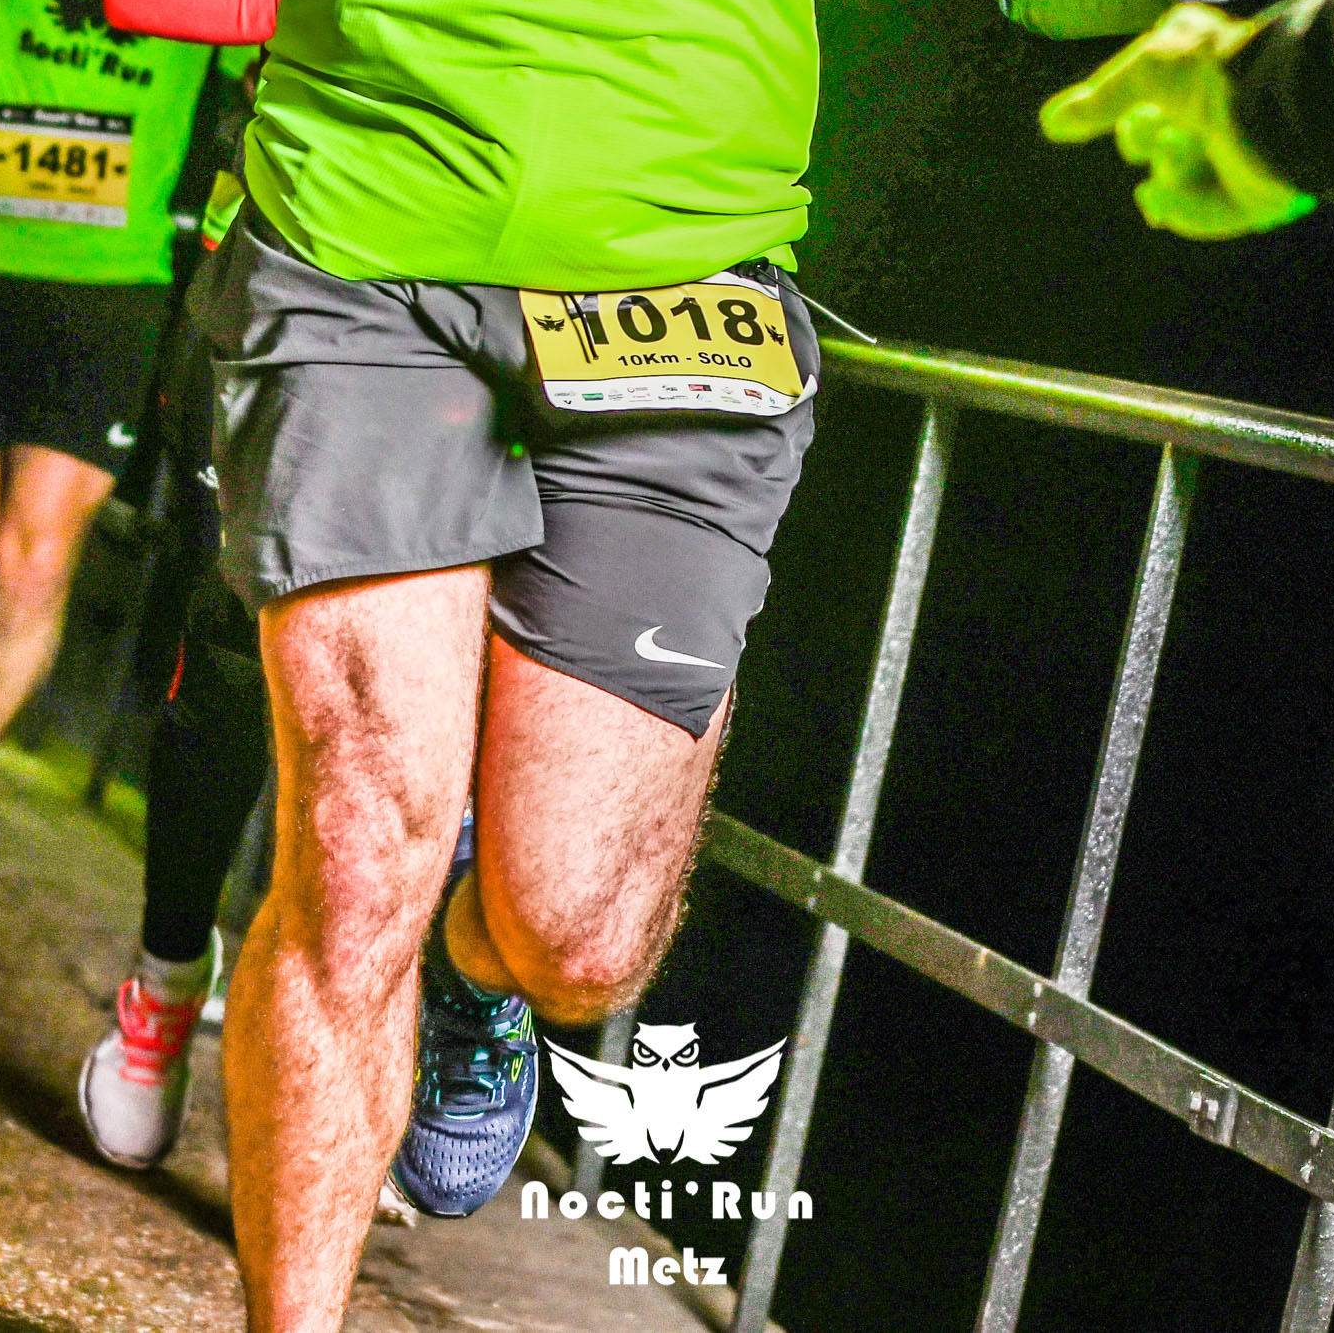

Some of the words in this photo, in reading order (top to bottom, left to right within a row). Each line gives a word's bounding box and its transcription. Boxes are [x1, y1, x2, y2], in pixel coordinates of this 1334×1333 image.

[14, 139, 109, 181] 1481
[568, 292, 765, 346] 1018
[617, 352, 680, 367] 10Km
[698, 351, 753, 369] SOLO
